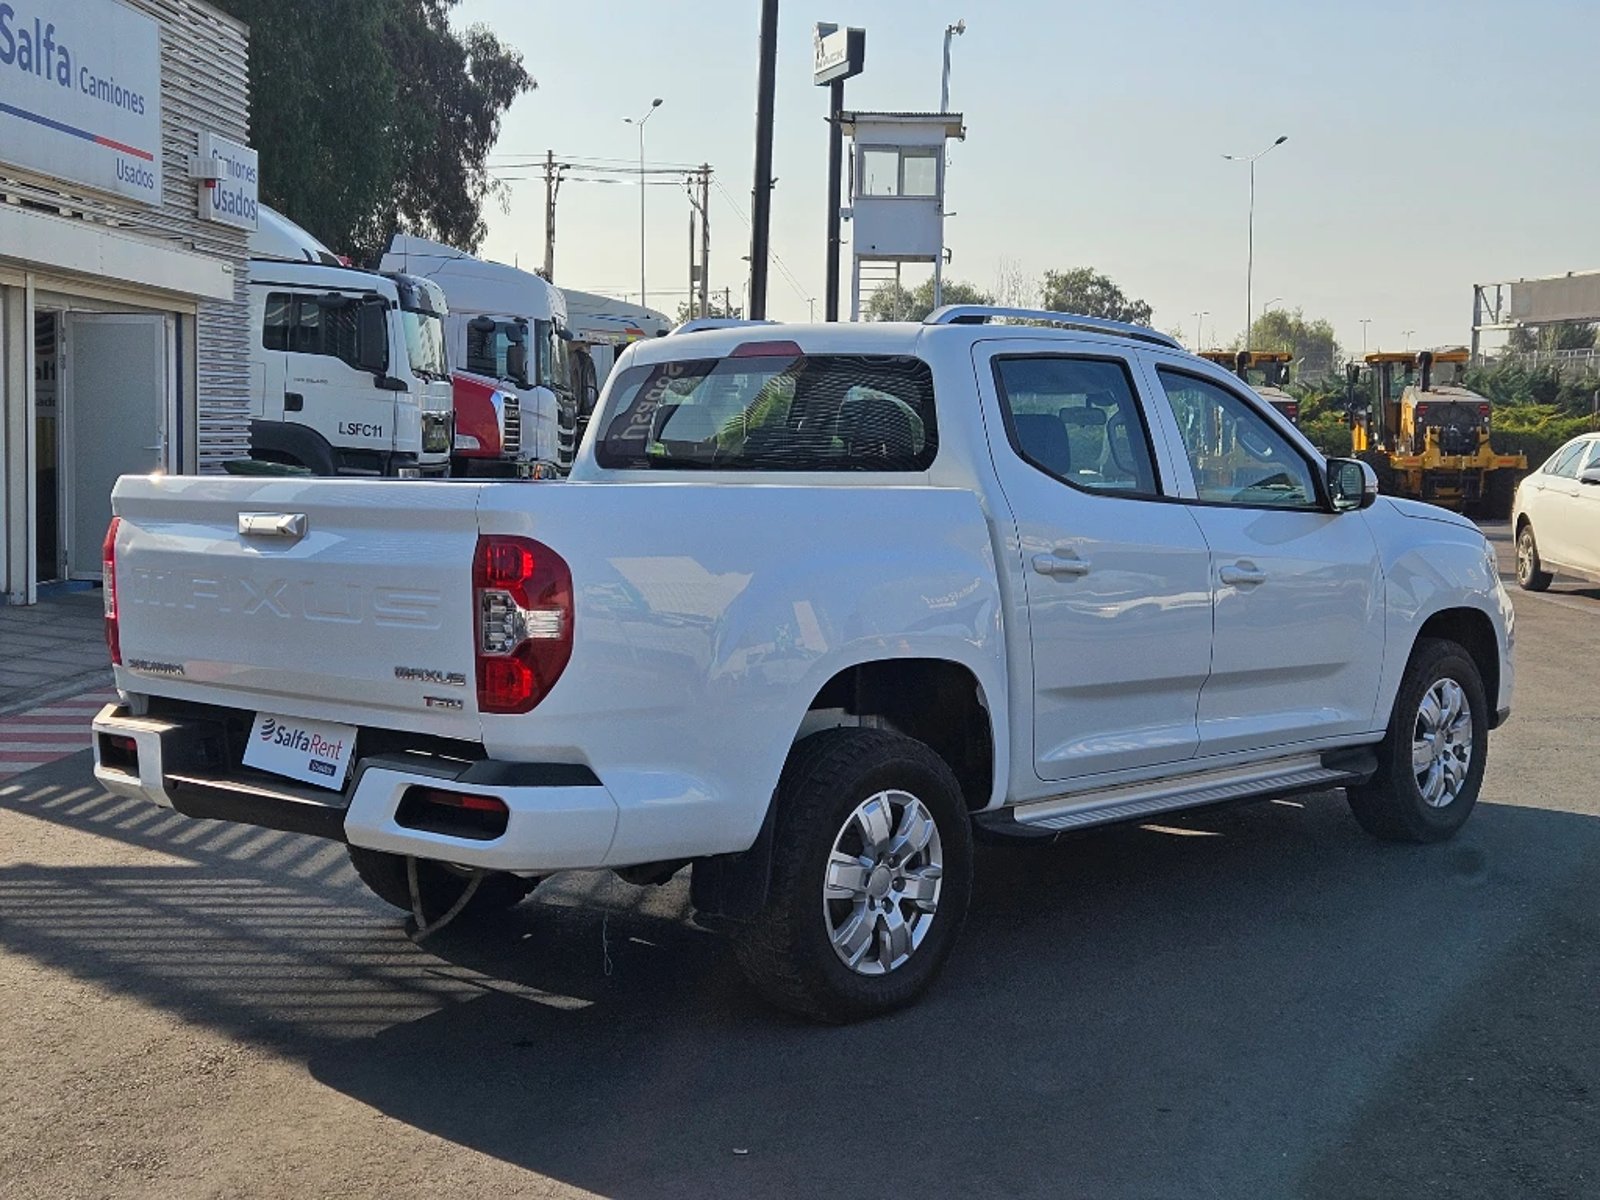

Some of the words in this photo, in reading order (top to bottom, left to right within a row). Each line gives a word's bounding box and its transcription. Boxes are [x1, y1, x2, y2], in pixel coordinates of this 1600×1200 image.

[0, 3, 71, 88] Salfa
[79, 65, 145, 116] Camiones
[116, 157, 154, 190] Usados
[212, 181, 256, 221] Usados
[338, 421, 382, 438] LSFC11
[394, 666, 466, 687] MAXUS
